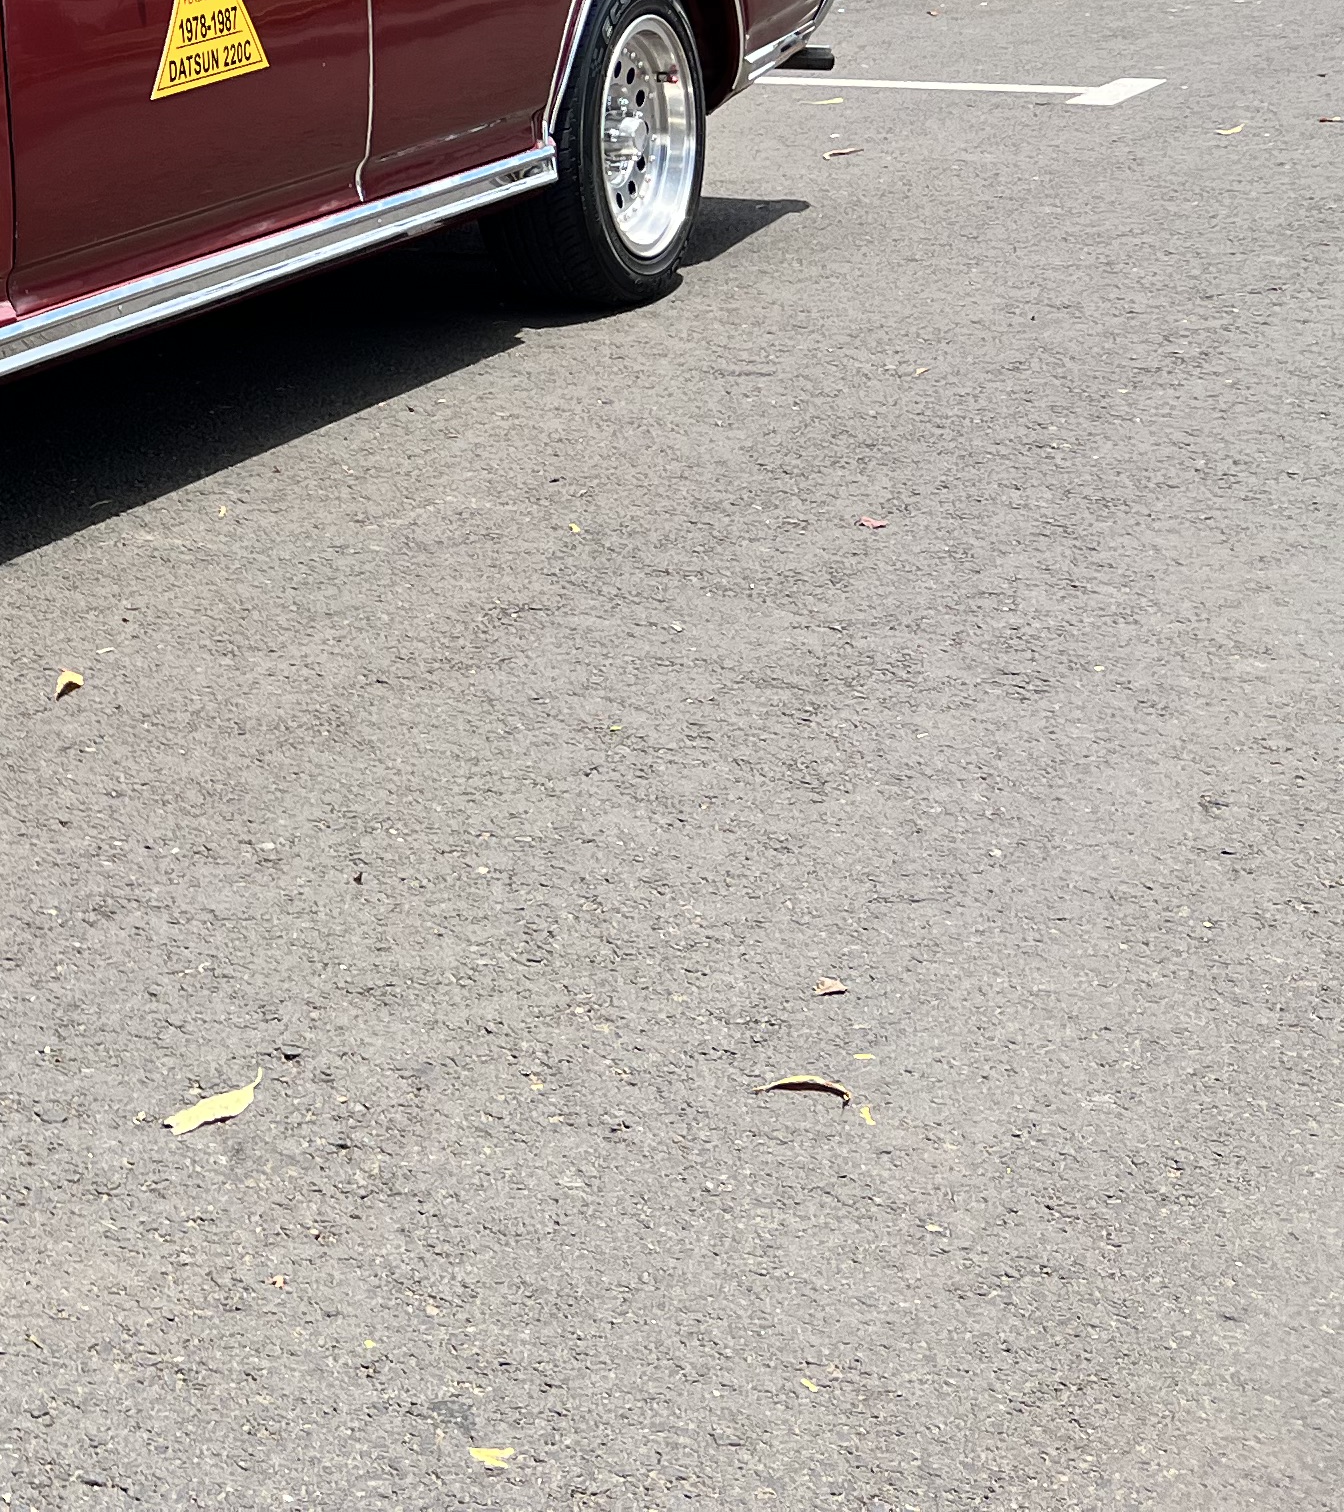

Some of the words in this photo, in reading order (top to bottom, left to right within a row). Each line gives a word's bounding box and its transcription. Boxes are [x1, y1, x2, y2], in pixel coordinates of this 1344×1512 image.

[178, 6, 238, 43] 1978-1987
[169, 47, 219, 83] DATSUN
[223, 39, 252, 67] 220C
